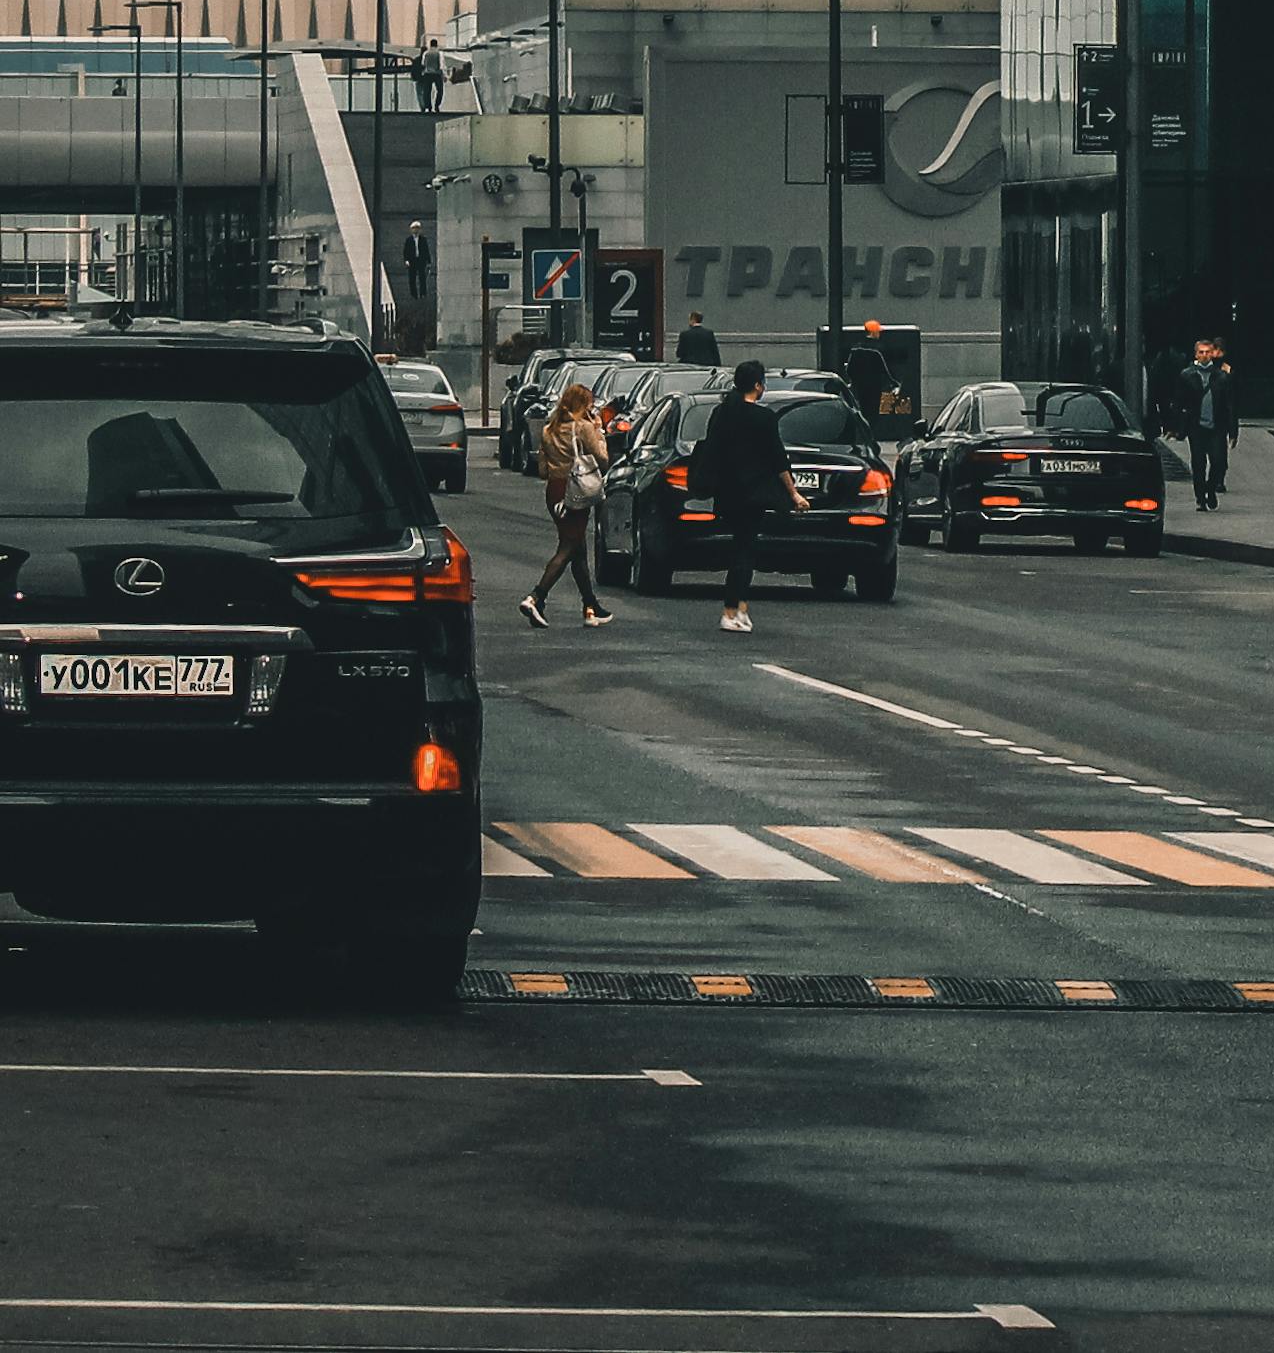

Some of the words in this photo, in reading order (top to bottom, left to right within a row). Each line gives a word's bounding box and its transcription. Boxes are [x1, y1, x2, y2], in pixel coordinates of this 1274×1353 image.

[675, 246, 1001, 298] ТРАНСН
[611, 269, 639, 318] 2
[52, 659, 173, 691] У001КЕ
[178, 656, 224, 683] 777
[189, 682, 214, 692] RUS
